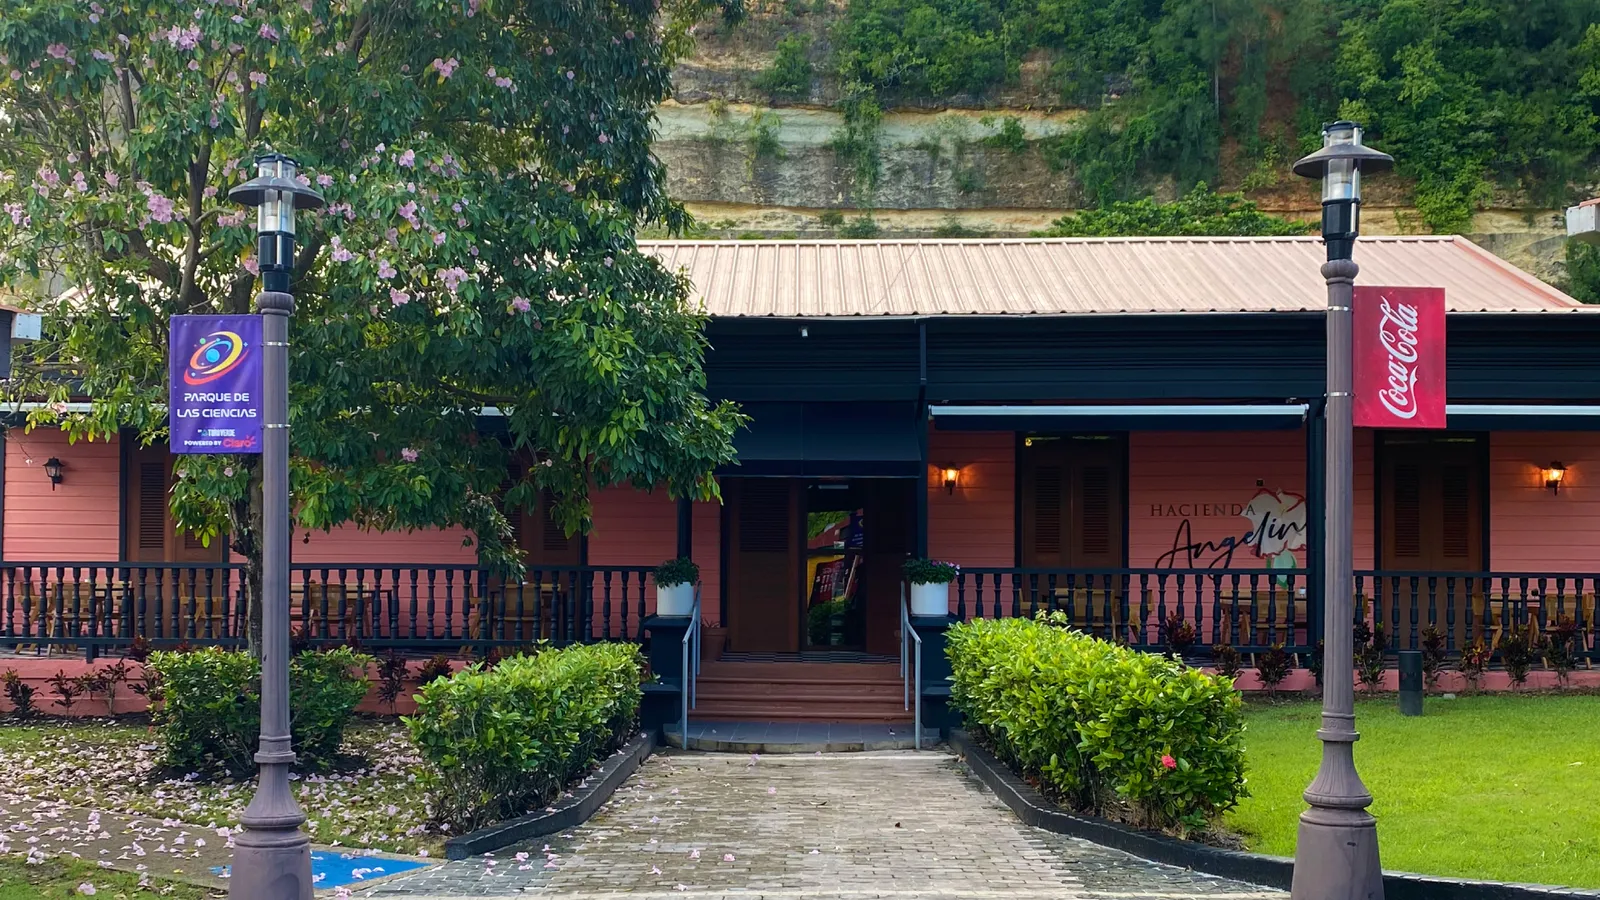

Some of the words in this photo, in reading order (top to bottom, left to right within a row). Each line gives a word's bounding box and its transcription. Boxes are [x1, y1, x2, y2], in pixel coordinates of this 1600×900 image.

[1378, 295, 1418, 419] Coca-Cola
[184, 393, 231, 402] PARQUE
[234, 393, 250, 402] DE
[177, 409, 200, 418] LAS
[202, 409, 257, 418] CIENCIAS
[1150, 503, 1256, 517] HACIENDA
[1155, 511, 1307, 579] Angelin
